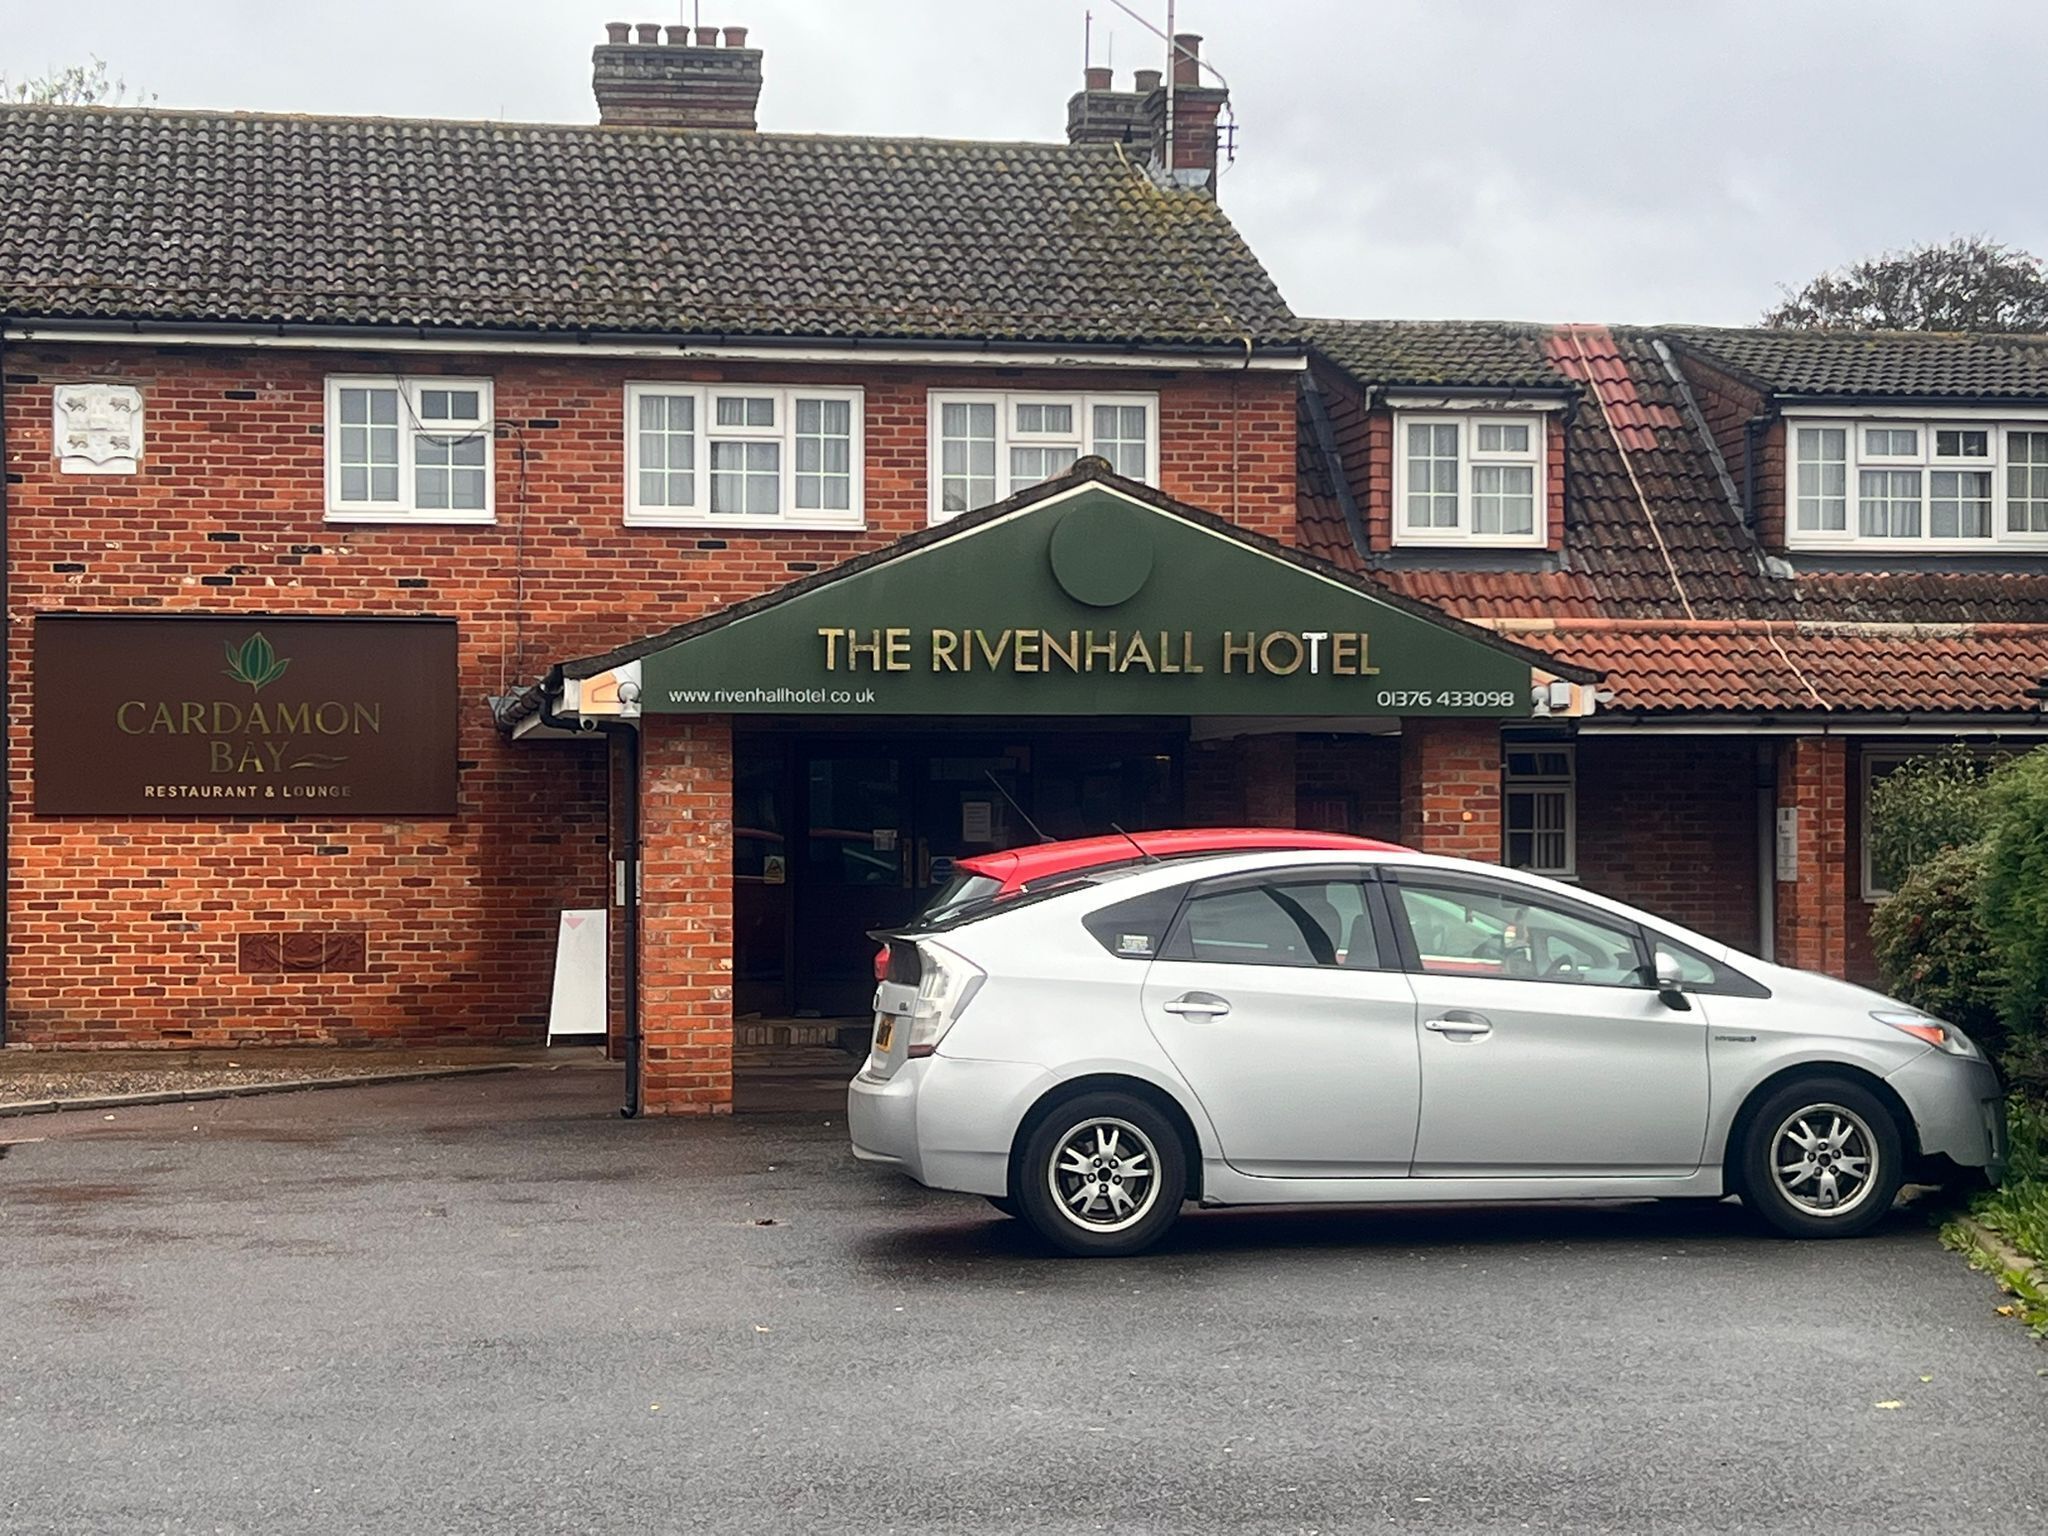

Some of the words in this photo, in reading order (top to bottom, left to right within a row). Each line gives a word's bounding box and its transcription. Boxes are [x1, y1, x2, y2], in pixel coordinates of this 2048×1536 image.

[818, 628, 911, 671] THE
[932, 628, 1204, 673] RIVENHALL
[1223, 629, 1380, 676] HOTEL
[1376, 690, 1432, 707] 01376
[1436, 690, 1514, 707] 433098
[116, 700, 381, 735] CARDAMON
[209, 740, 290, 773] BAY
[144, 785, 258, 798] RESTAURANT
[264, 785, 275, 798] &
[282, 785, 351, 798] LOUNGE
